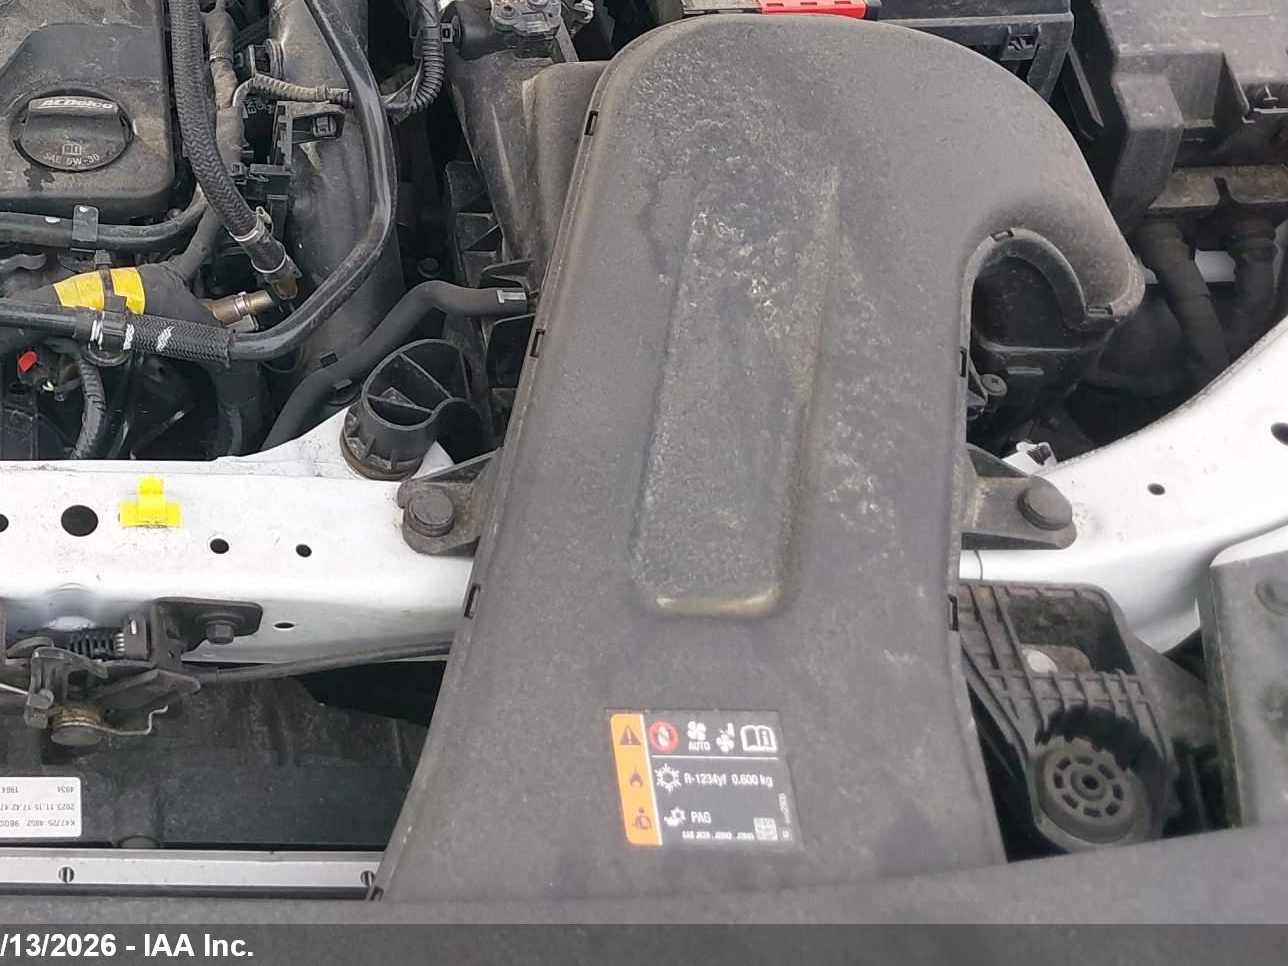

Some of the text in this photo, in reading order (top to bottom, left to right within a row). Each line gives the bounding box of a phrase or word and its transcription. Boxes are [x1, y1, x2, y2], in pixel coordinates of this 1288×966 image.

[39, 98, 114, 109] ACDelco
[43, 152, 101, 165] SAE 5W-30
[688, 741, 711, 751] AUTO
[683, 772, 774, 788] R-1234yf 0.600 kg
[691, 811, 712, 824] PAG
